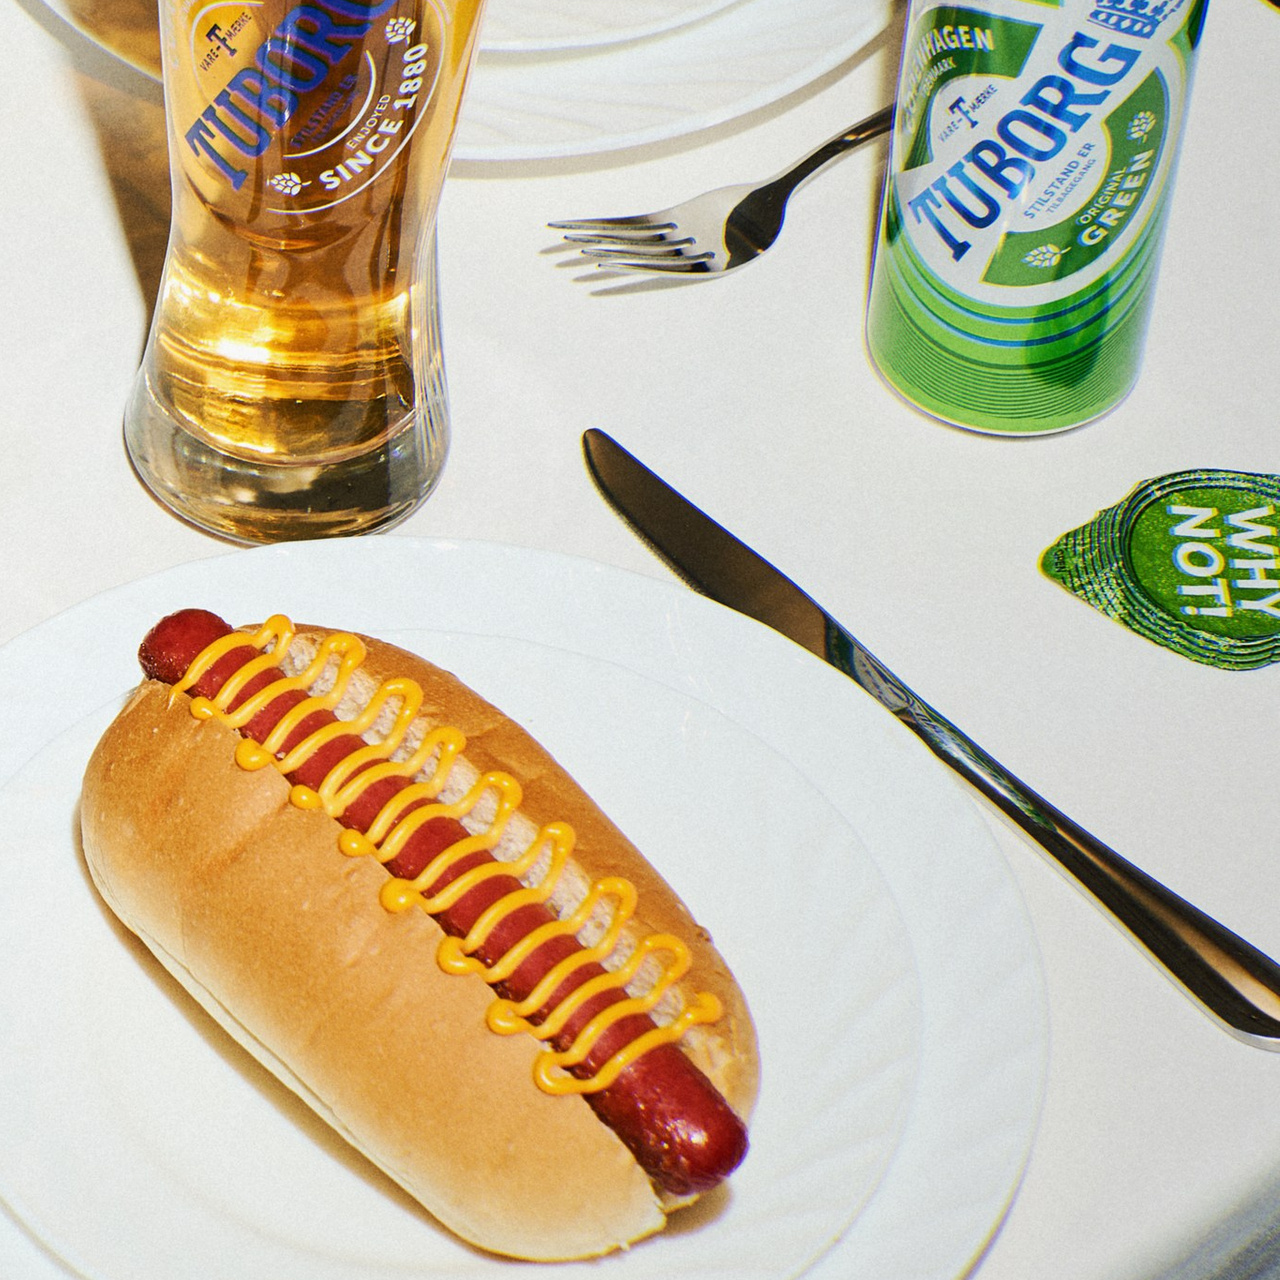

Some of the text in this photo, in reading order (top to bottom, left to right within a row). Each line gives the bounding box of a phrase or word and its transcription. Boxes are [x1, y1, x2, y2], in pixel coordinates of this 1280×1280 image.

[318, 118, 405, 191] SINCE
[392, 41, 430, 111] 1880
[346, 93, 391, 151] ENJOYED
[906, 31, 1143, 264] TUBORG
[1022, 140, 1097, 221] STILSTAND ER
[1045, 157, 1098, 215] TILBAGEGANG
[1077, 166, 1128, 226] ORIGINAL
[1077, 147, 1155, 249] GREEN
[1166, 505, 1233, 618] NOT!
[1223, 504, 1280, 619] WHY
